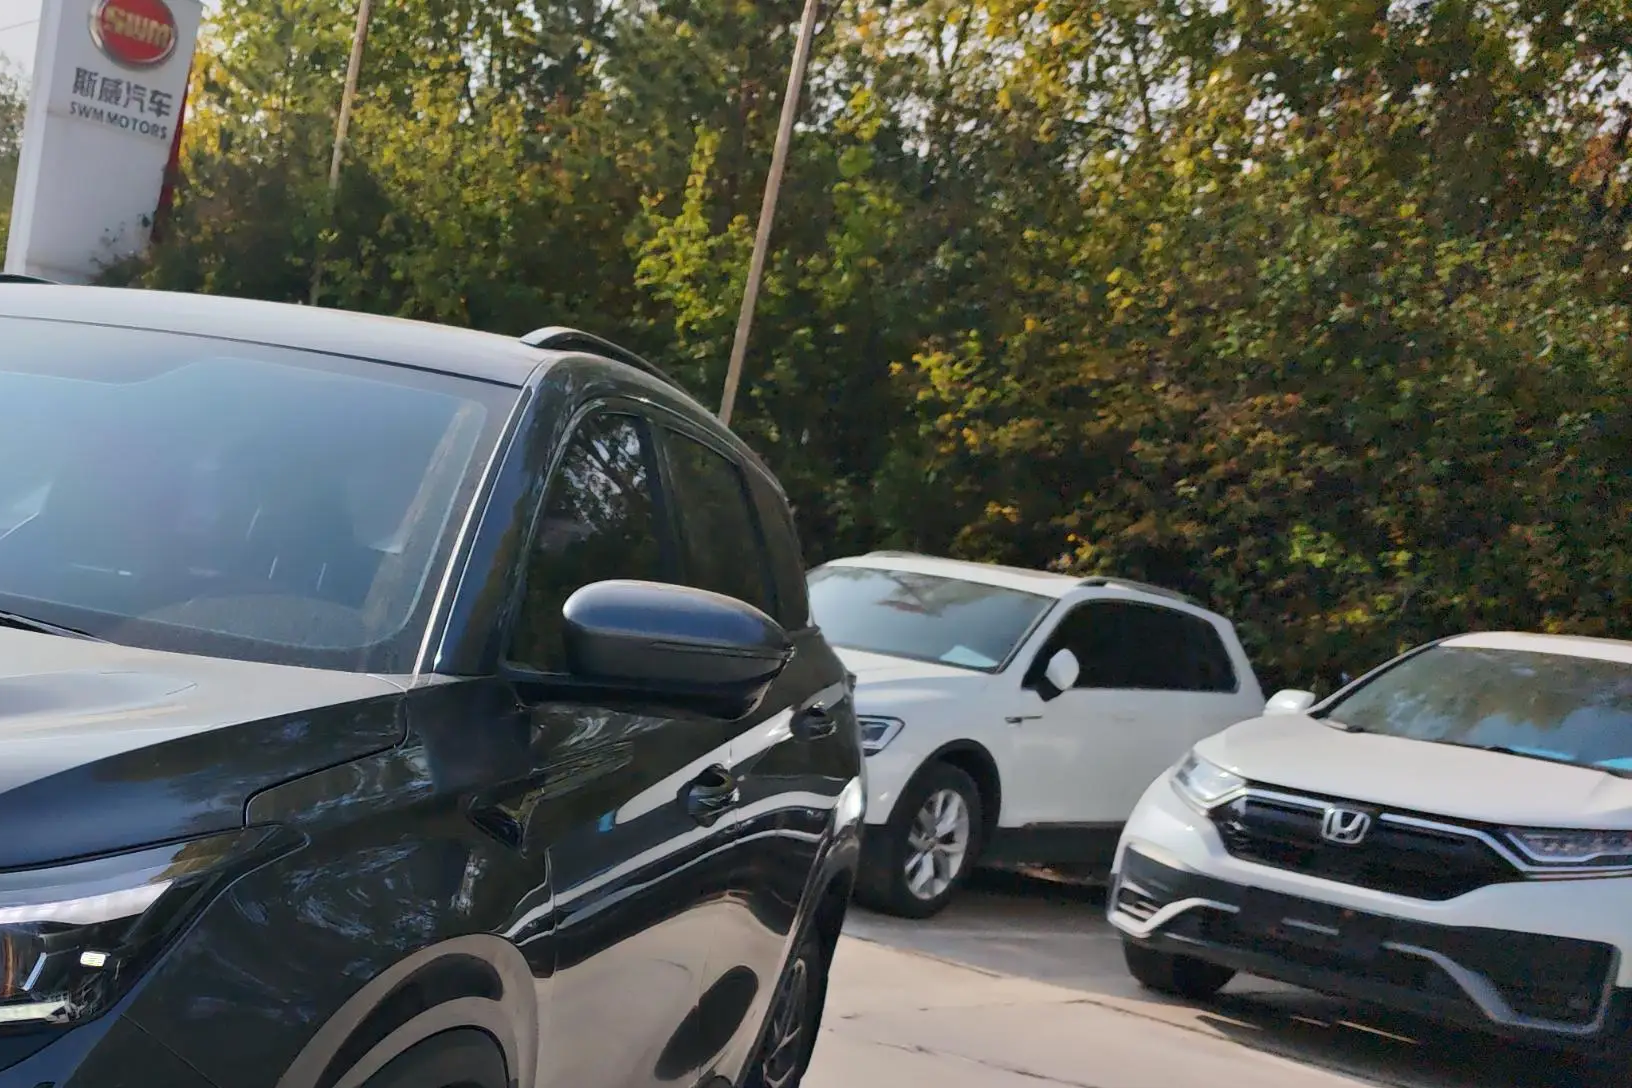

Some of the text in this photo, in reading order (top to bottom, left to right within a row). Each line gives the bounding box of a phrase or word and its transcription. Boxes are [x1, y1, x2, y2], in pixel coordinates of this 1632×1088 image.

[72, 67, 173, 117] 斯威汽车
[69, 102, 168, 139] SWM MOTORS
